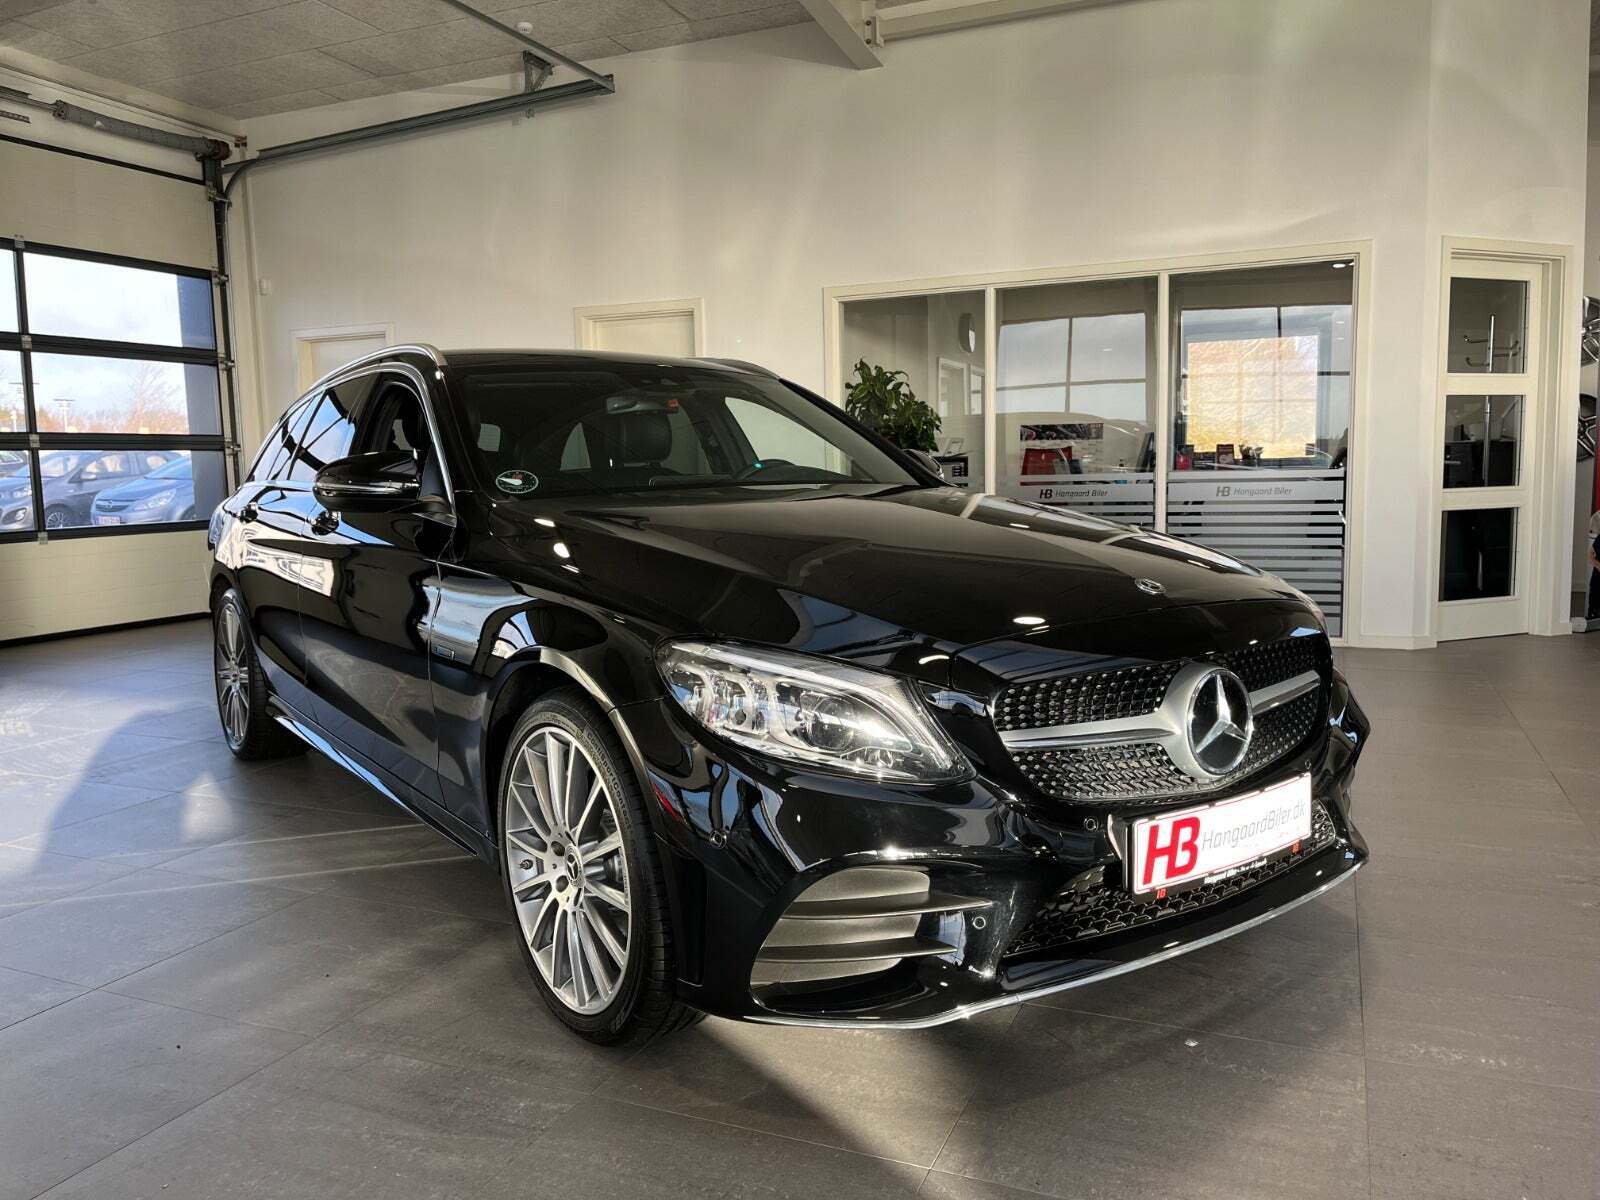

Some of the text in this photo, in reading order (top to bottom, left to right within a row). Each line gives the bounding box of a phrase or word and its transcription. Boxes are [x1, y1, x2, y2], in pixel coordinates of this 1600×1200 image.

[1040, 488, 1053, 499] HB
[1216, 486, 1231, 497] HB
[1142, 816, 1201, 886] HB
[1201, 799, 1306, 852] HangaardBiler.dk
